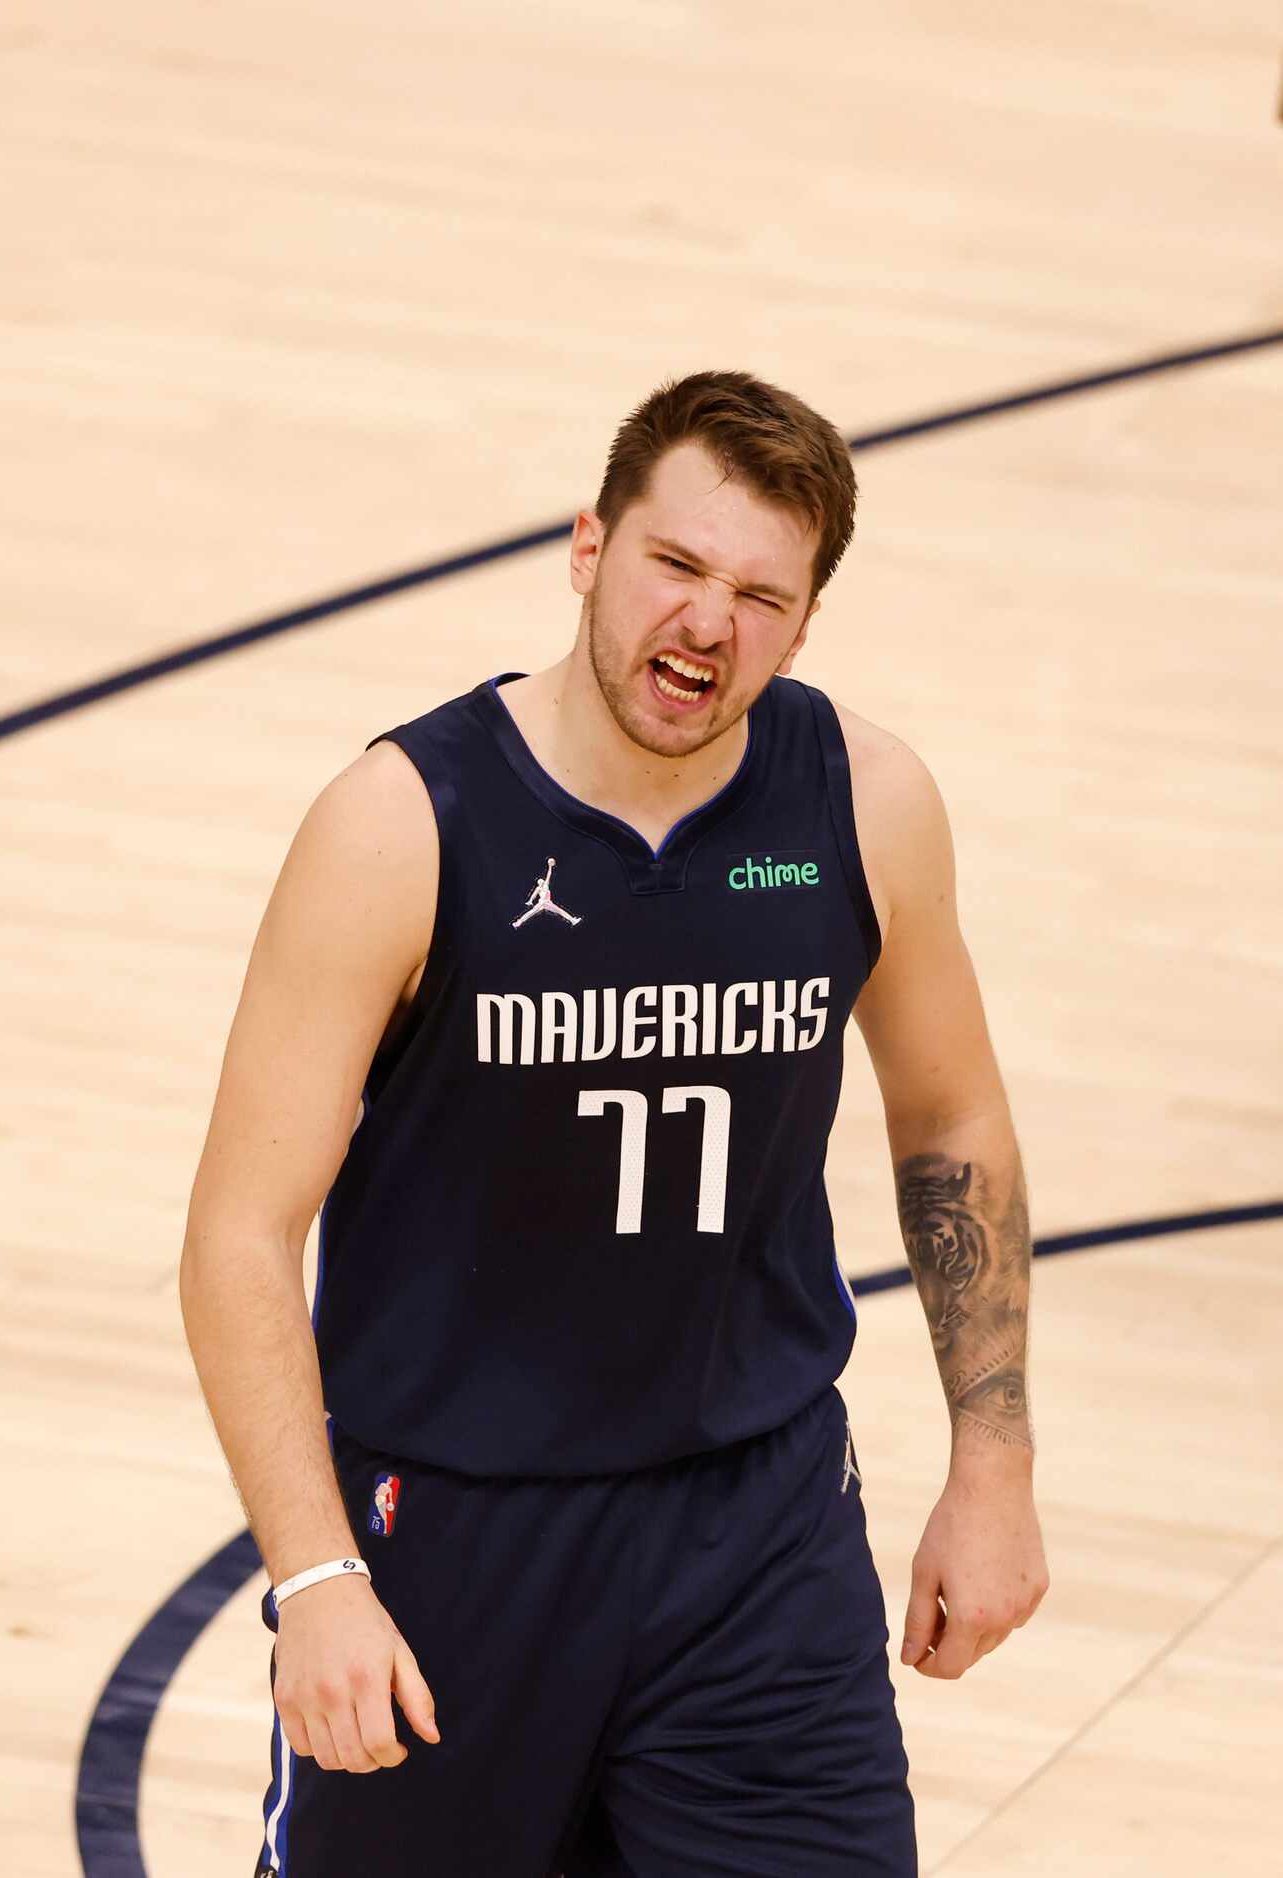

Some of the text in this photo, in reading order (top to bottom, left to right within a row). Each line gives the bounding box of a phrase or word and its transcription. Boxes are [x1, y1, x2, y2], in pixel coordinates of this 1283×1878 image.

[727, 856, 820, 890] chime
[476, 976, 831, 1066] MAVERICKS
[577, 1085, 732, 1235] 77
